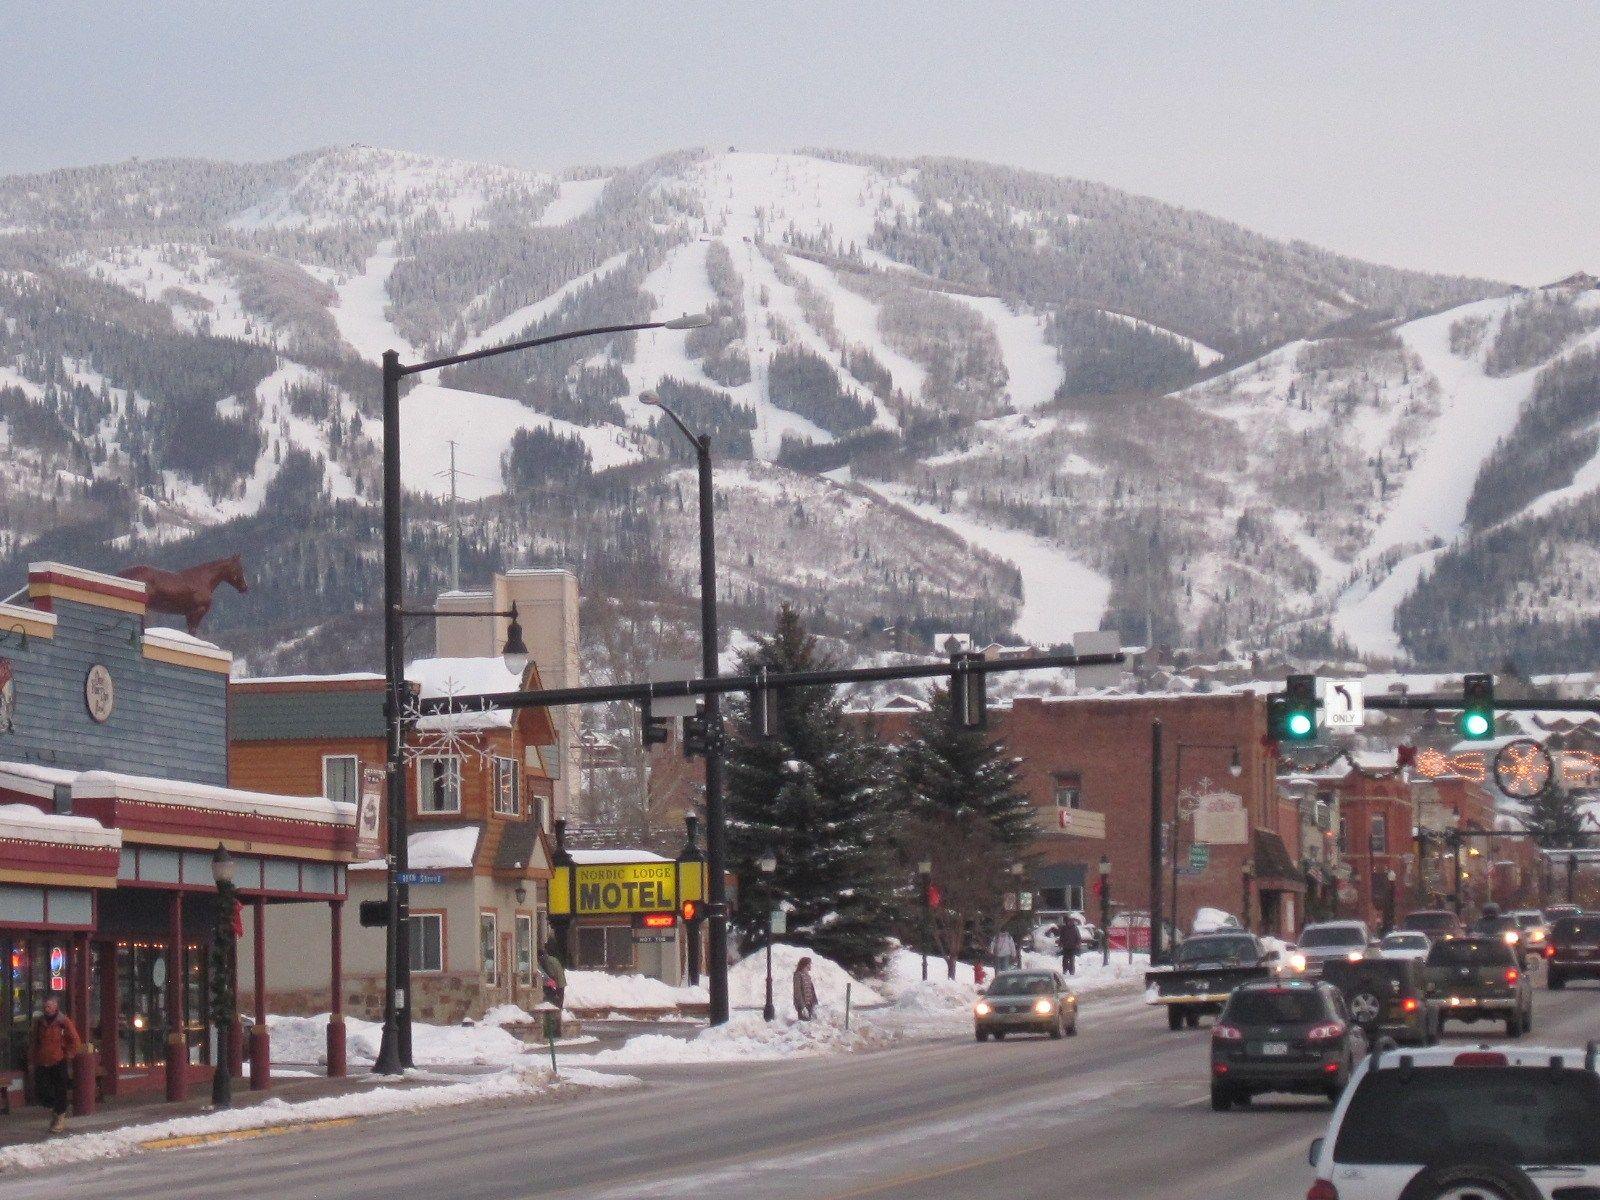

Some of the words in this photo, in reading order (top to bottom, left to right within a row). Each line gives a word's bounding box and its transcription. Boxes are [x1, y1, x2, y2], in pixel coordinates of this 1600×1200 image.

[1332, 714, 1355, 723] ONLY
[581, 869, 625, 881] NORDIC
[633, 867, 671, 879] LODGE
[579, 880, 672, 910] MOTEL
